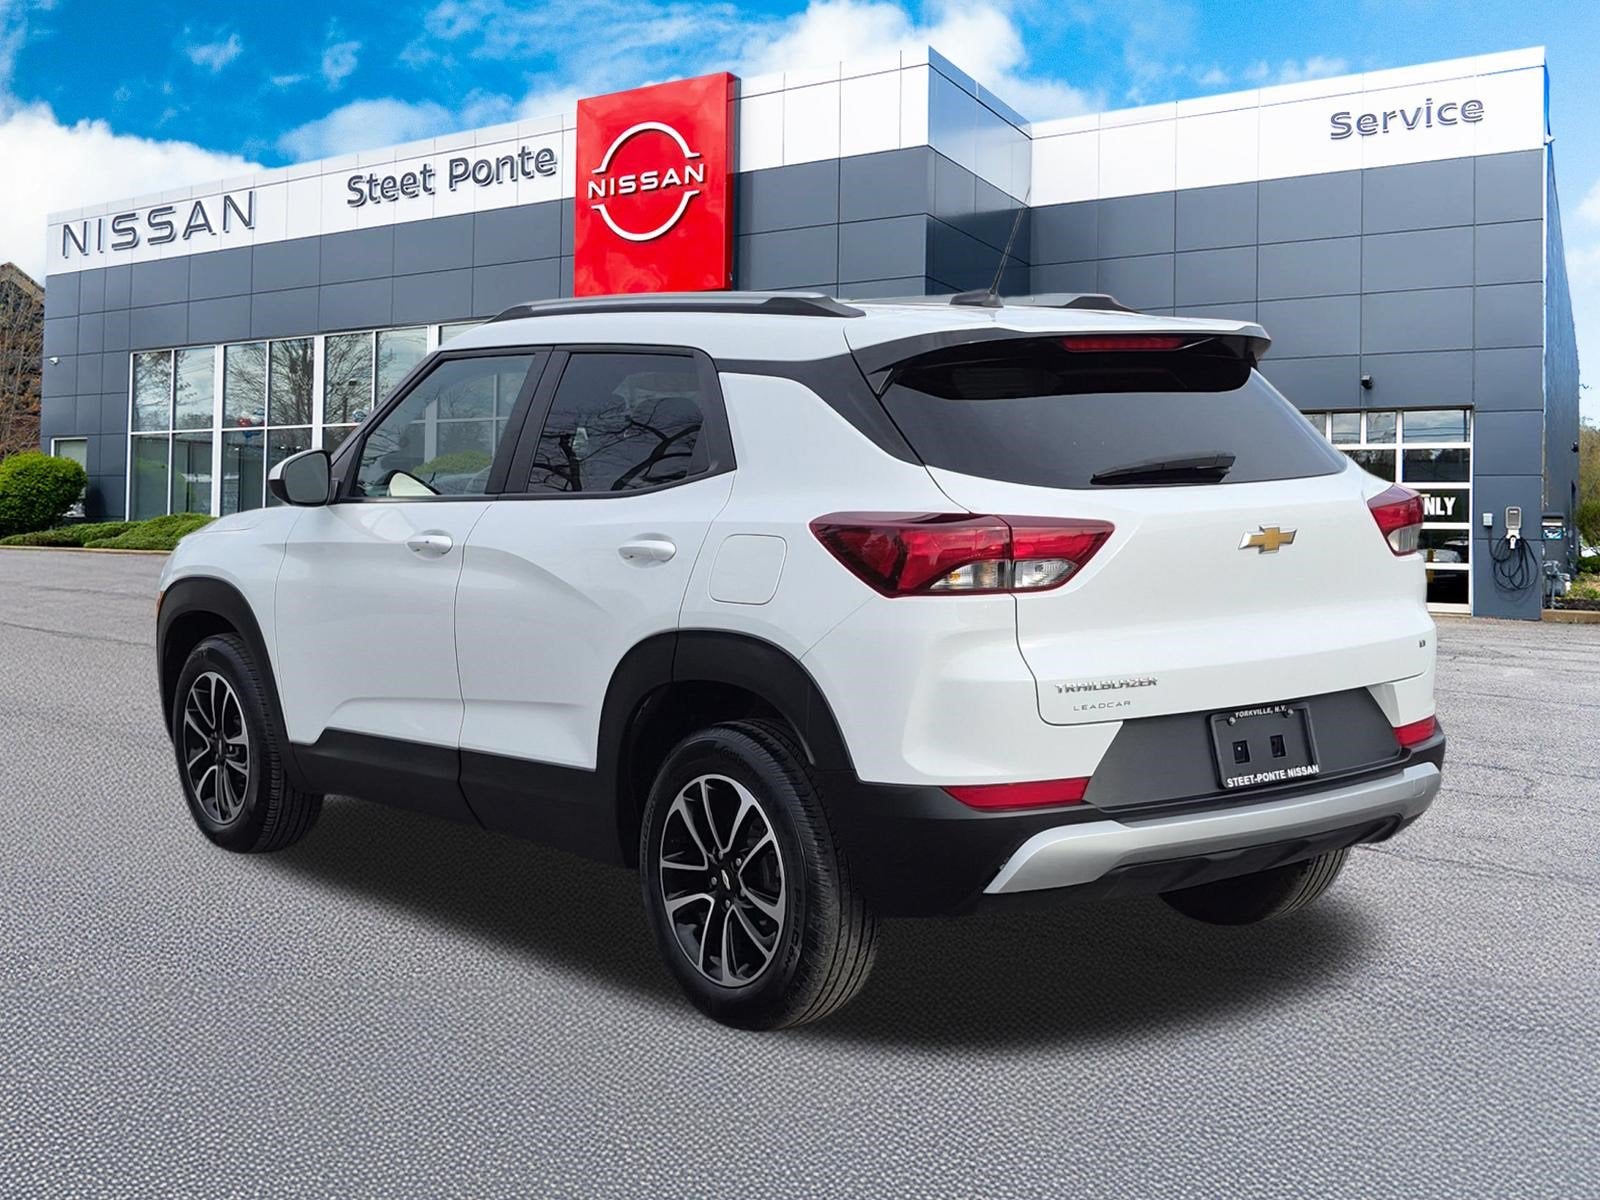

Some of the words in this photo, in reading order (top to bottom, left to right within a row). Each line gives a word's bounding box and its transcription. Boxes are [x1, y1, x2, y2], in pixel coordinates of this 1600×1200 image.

[1330, 98, 1484, 140] Service
[347, 163, 436, 208] Steet
[449, 145, 558, 192] Ponte
[587, 163, 705, 200] NISSAN
[62, 190, 257, 259] NISSAN
[1423, 496, 1457, 516] NLY
[1055, 677, 1158, 694] TRAILBLAZER
[1073, 700, 1131, 712] LEADCAR
[1227, 770, 1287, 788] STEET-PONTE
[1288, 765, 1320, 779] NISSAN
